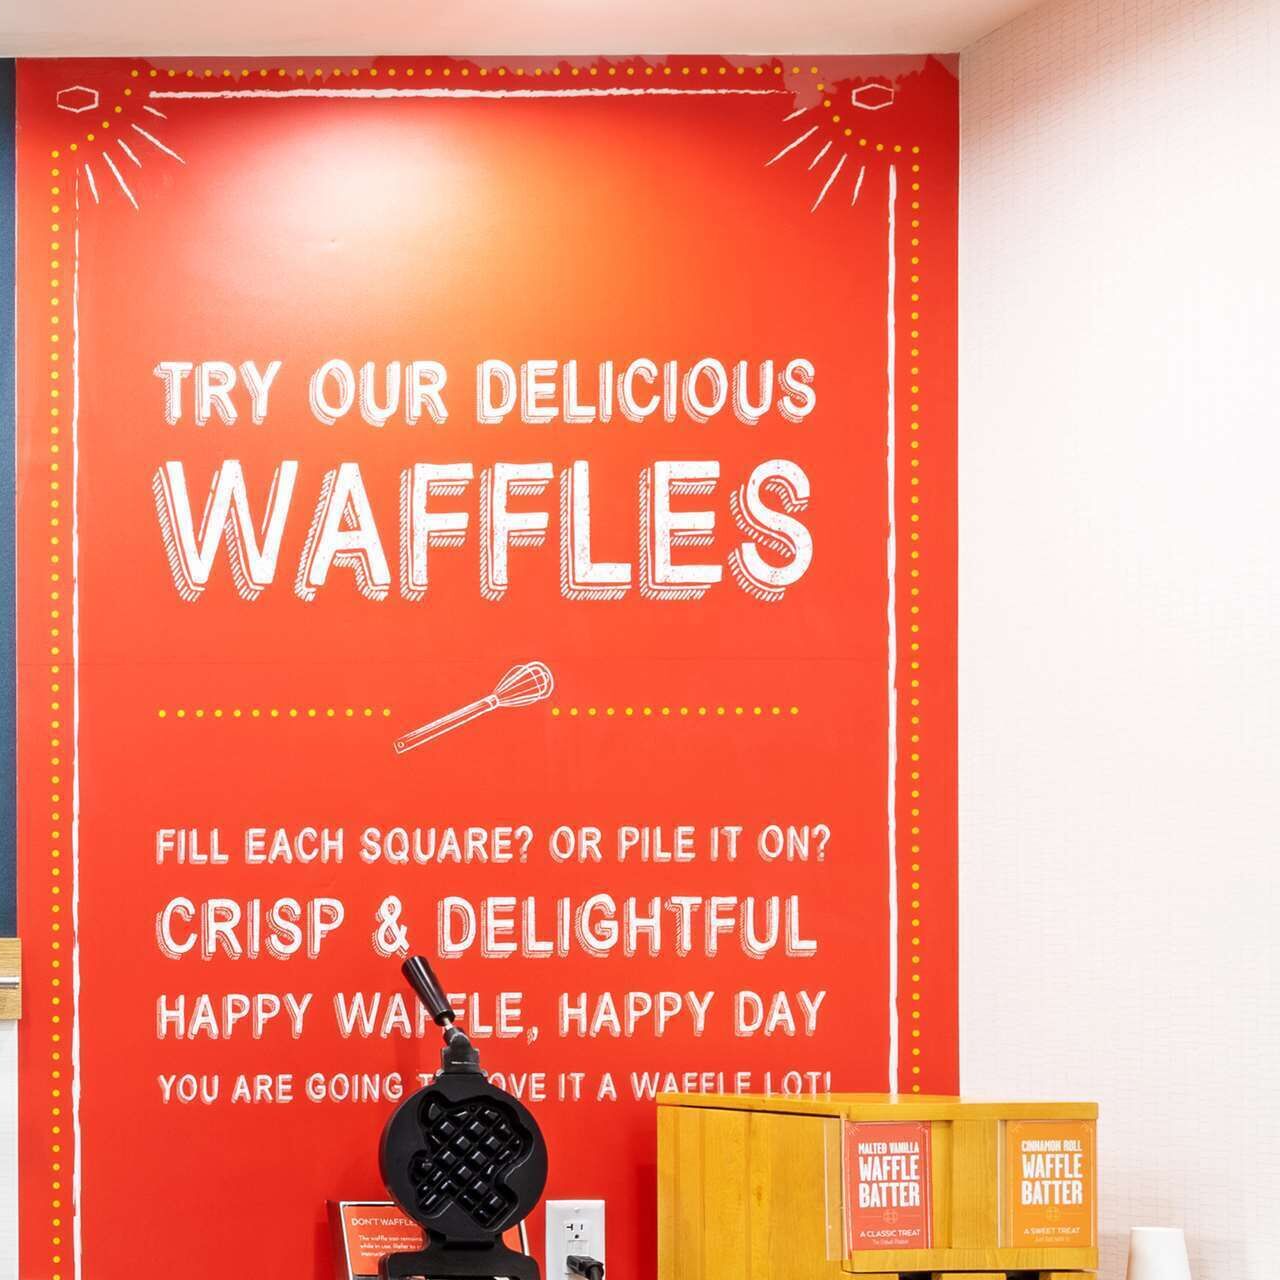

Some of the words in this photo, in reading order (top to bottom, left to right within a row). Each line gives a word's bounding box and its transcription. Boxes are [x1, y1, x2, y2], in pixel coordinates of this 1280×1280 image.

[154, 360, 282, 426] TRY
[309, 358, 448, 427] OUR
[477, 358, 816, 425] DELICIOUS
[152, 459, 813, 602] WAFFLES
[156, 828, 228, 864] FILL
[245, 827, 344, 864] EACH
[360, 826, 533, 864] SQUARE?
[549, 826, 602, 861] OR
[617, 826, 695, 862] PILE
[711, 826, 742, 861] IT
[757, 824, 831, 861] ON?
[156, 896, 344, 960] CRISP
[373, 896, 409, 954] &
[438, 894, 817, 959] DELIGHTFUL
[157, 993, 312, 1039] HAPPY
[559, 991, 714, 1038] HAPPY
[735, 991, 826, 1036] DAY
[159, 1074, 219, 1104] YOU
[232, 1074, 293, 1103] ARE
[306, 1072, 403, 1102] GOING
[559, 1072, 585, 1101] IT
[597, 1073, 618, 1101] A
[858, 1142, 887, 1155] MALTED
[889, 1141, 920, 1154] VANILLA
[858, 1155, 920, 1182] WAFFLE
[1022, 1153, 1083, 1179] WAFFLE
[858, 1182, 920, 1209] BATTER
[1021, 1180, 1083, 1205] BATTER
[867, 1230, 897, 1238] CLASSIC
[898, 1228, 921, 1237] TREAT
